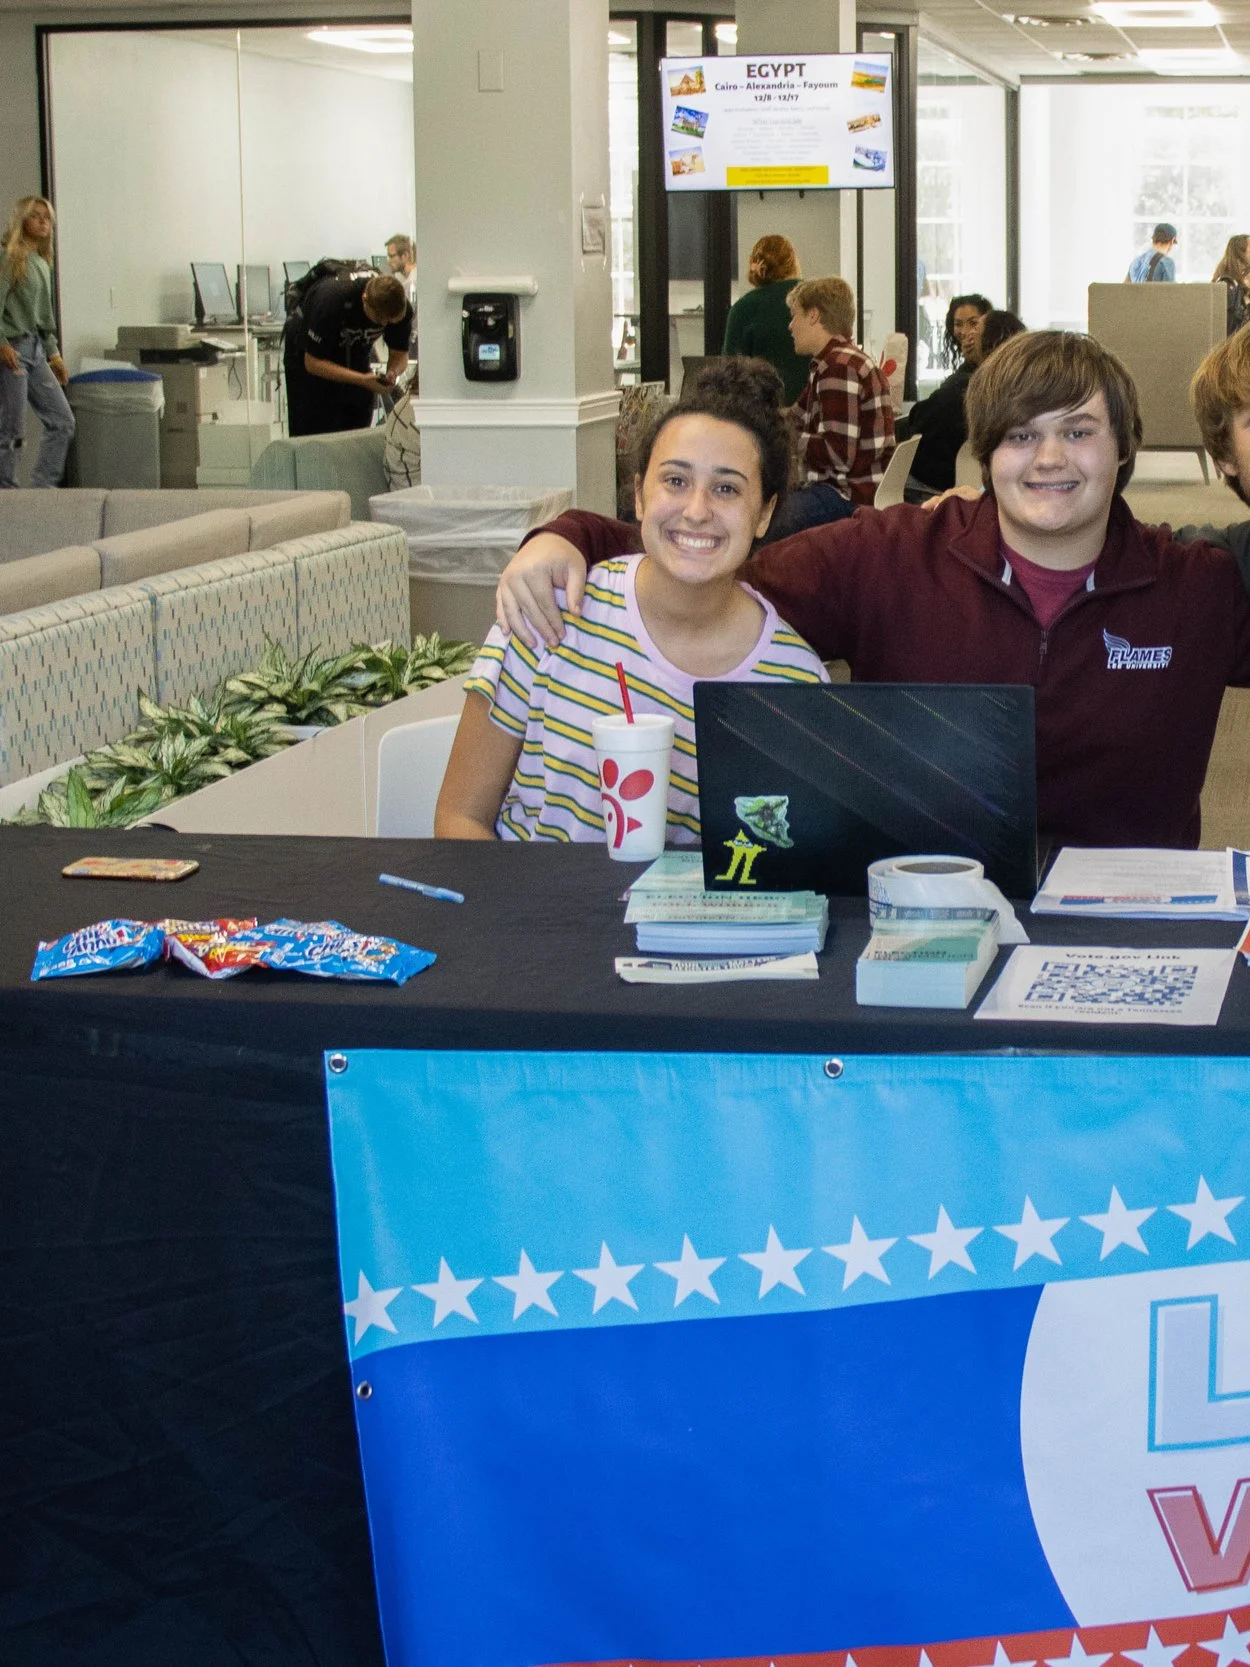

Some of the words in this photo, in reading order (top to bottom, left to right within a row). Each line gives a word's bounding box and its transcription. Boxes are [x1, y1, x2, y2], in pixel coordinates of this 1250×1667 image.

[746, 63, 806, 78] EGYPT
[715, 82, 738, 91] Cairo
[746, 81, 795, 91] Alexandria
[803, 80, 839, 91] Fayoum
[778, 94, 800, 102] 12/17
[1109, 648, 1172, 662] FLAMES
[1066, 953, 1141, 961] Vote.gov
